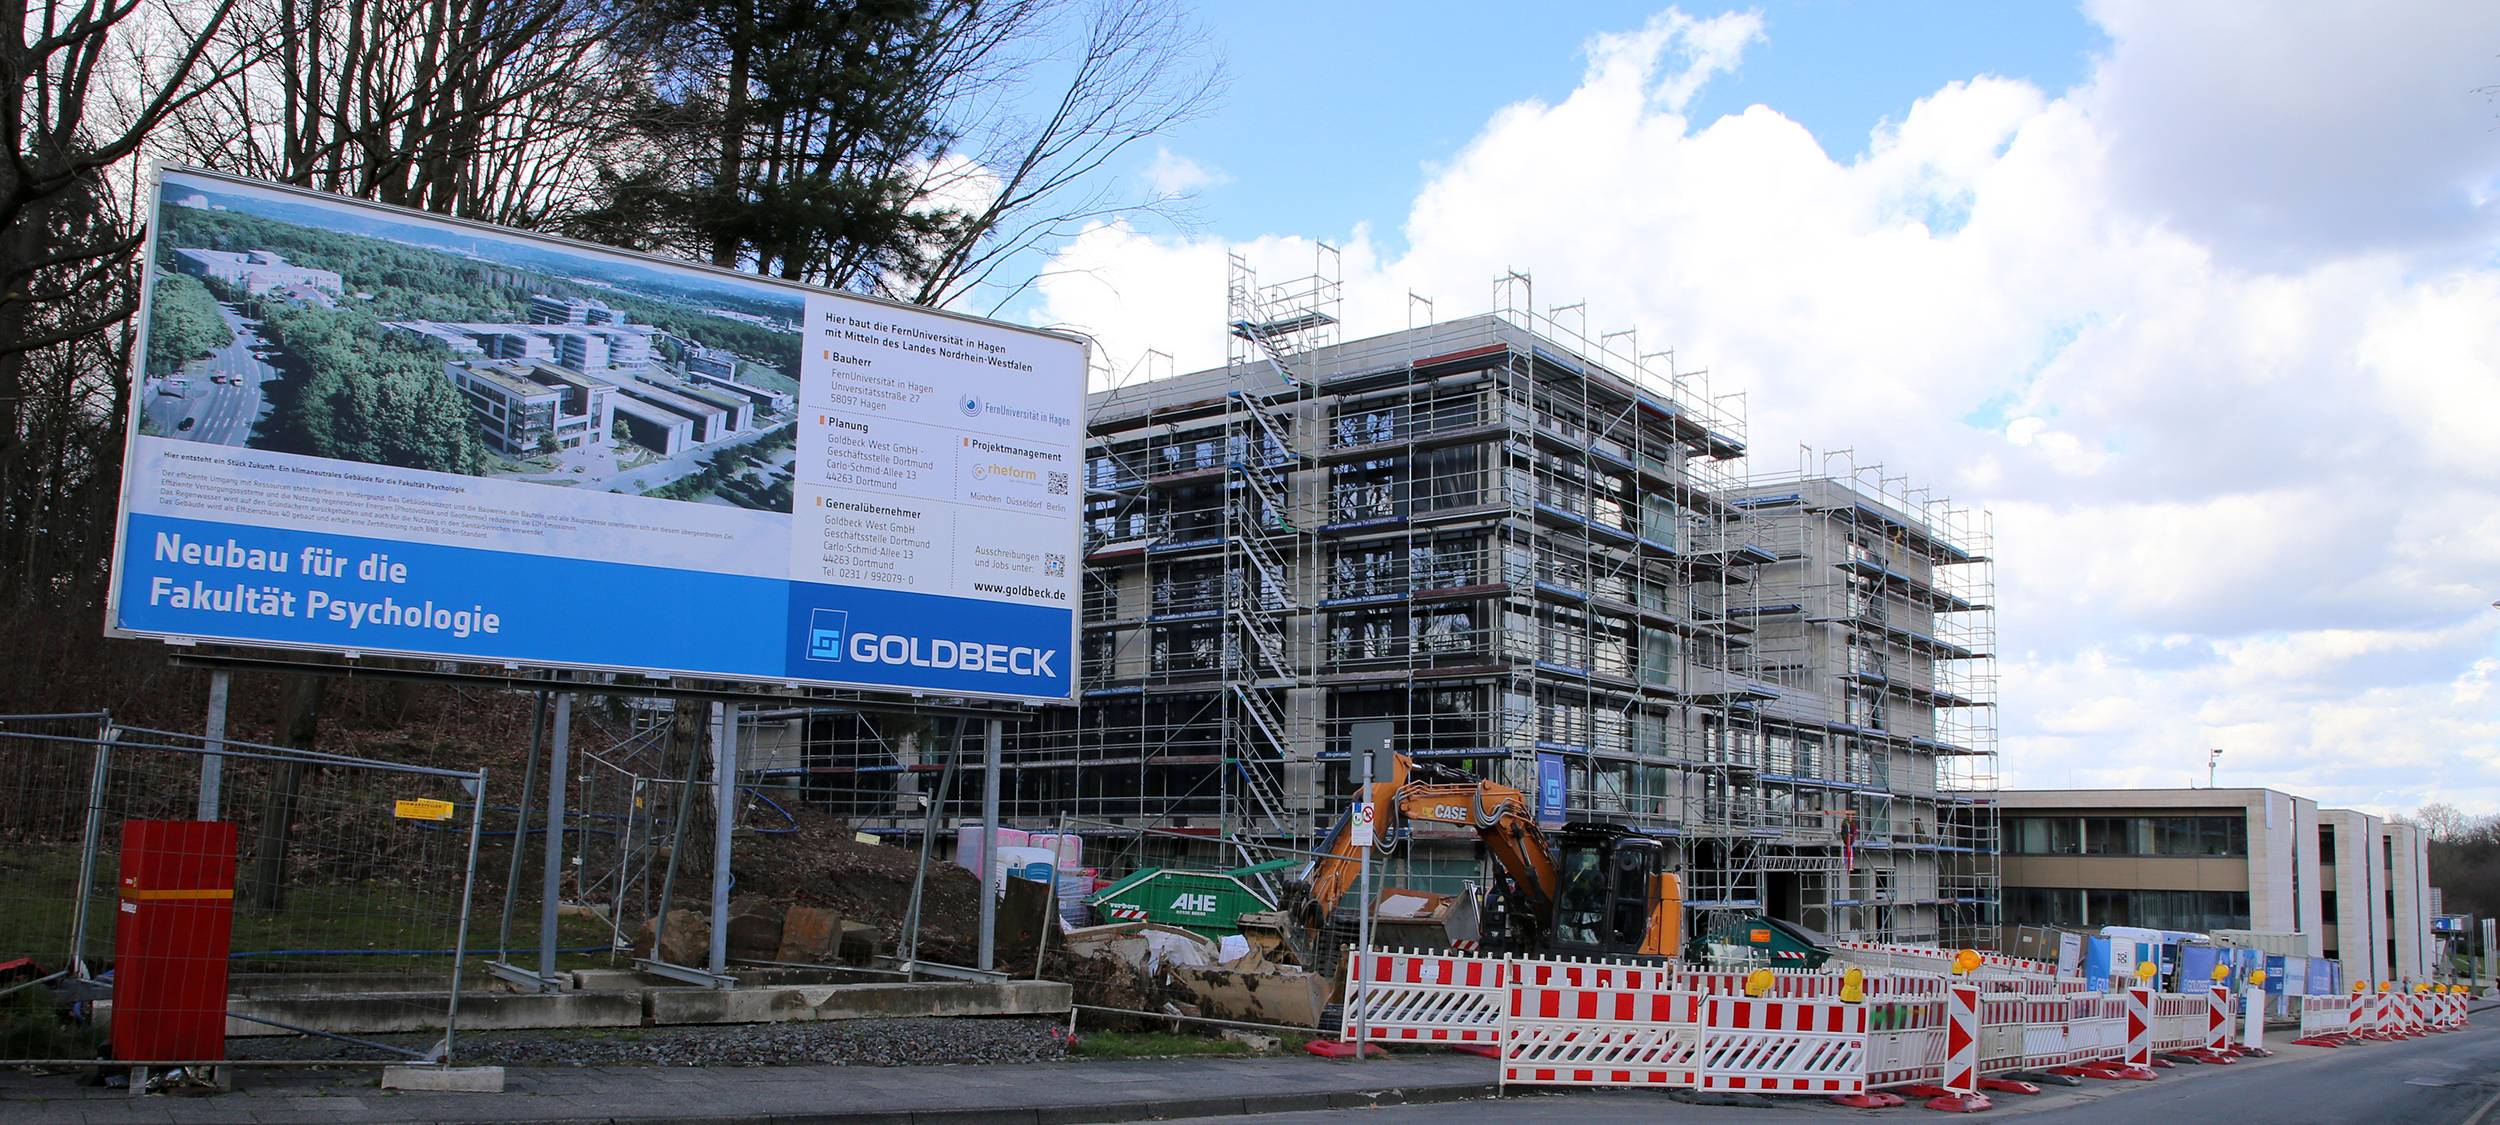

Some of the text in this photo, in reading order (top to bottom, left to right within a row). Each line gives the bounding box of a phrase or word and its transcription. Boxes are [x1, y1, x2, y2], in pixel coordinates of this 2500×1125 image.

[825, 312, 1006, 354] Hier baut die FernUniversität in Hagen
[825, 328, 1033, 372] mit Mitteln des Landes Nordrhein-Westfalen
[832, 351, 872, 367] Bauherr
[831, 368, 934, 394] FernUniversität in Hagen
[830, 393, 887, 411] 58097 Hagen
[909, 393, 920, 403] 27
[985, 402, 1071, 427] FernUniversität in Hagen
[828, 416, 869, 434] Planung
[827, 433, 866, 448] Goldbeck
[868, 439, 890, 451] West
[892, 443, 918, 455] GmbH
[972, 439, 1062, 462] Projektmanagement
[164, 451, 180, 459] Hier
[181, 454, 212, 463] entsteht
[226, 458, 246, 467] Stück
[248, 461, 276, 471] Zukunft.
[278, 464, 290, 472] Ein
[291, 467, 342, 479] klimaneutrales
[343, 472, 373, 482] Gebäude
[374, 476, 385, 484] für
[826, 459, 917, 481] Carlo-Schmid-Allee 13
[893, 455, 934, 470] Dortmund
[988, 463, 1037, 480] rheform
[825, 471, 897, 490] 44263 Dortmund
[825, 498, 921, 519] Generalübernehmer
[970, 491, 1066, 512] München Düsseldorf Berlin
[824, 514, 915, 534] Goldbeck West GmbH
[823, 540, 914, 560] Carlo-Schmid-Allee 13
[889, 535, 931, 549] Dortmund
[155, 533, 407, 584] Neubau für die
[822, 554, 894, 570] 44263 Dortmund
[974, 558, 990, 568] und
[991, 559, 1010, 570] Jobs
[975, 545, 1040, 563] Ausschreibungen
[839, 568, 861, 580] 0231
[863, 570, 869, 580] /
[908, 575, 914, 585] 0
[974, 583, 1066, 600] www.goldbeck.de
[150, 577, 500, 637] Fakultät Psychologie
[850, 633, 1057, 678] GOLDBECK
[1434, 804, 1467, 821] CASE
[1170, 893, 1216, 913] AHE
